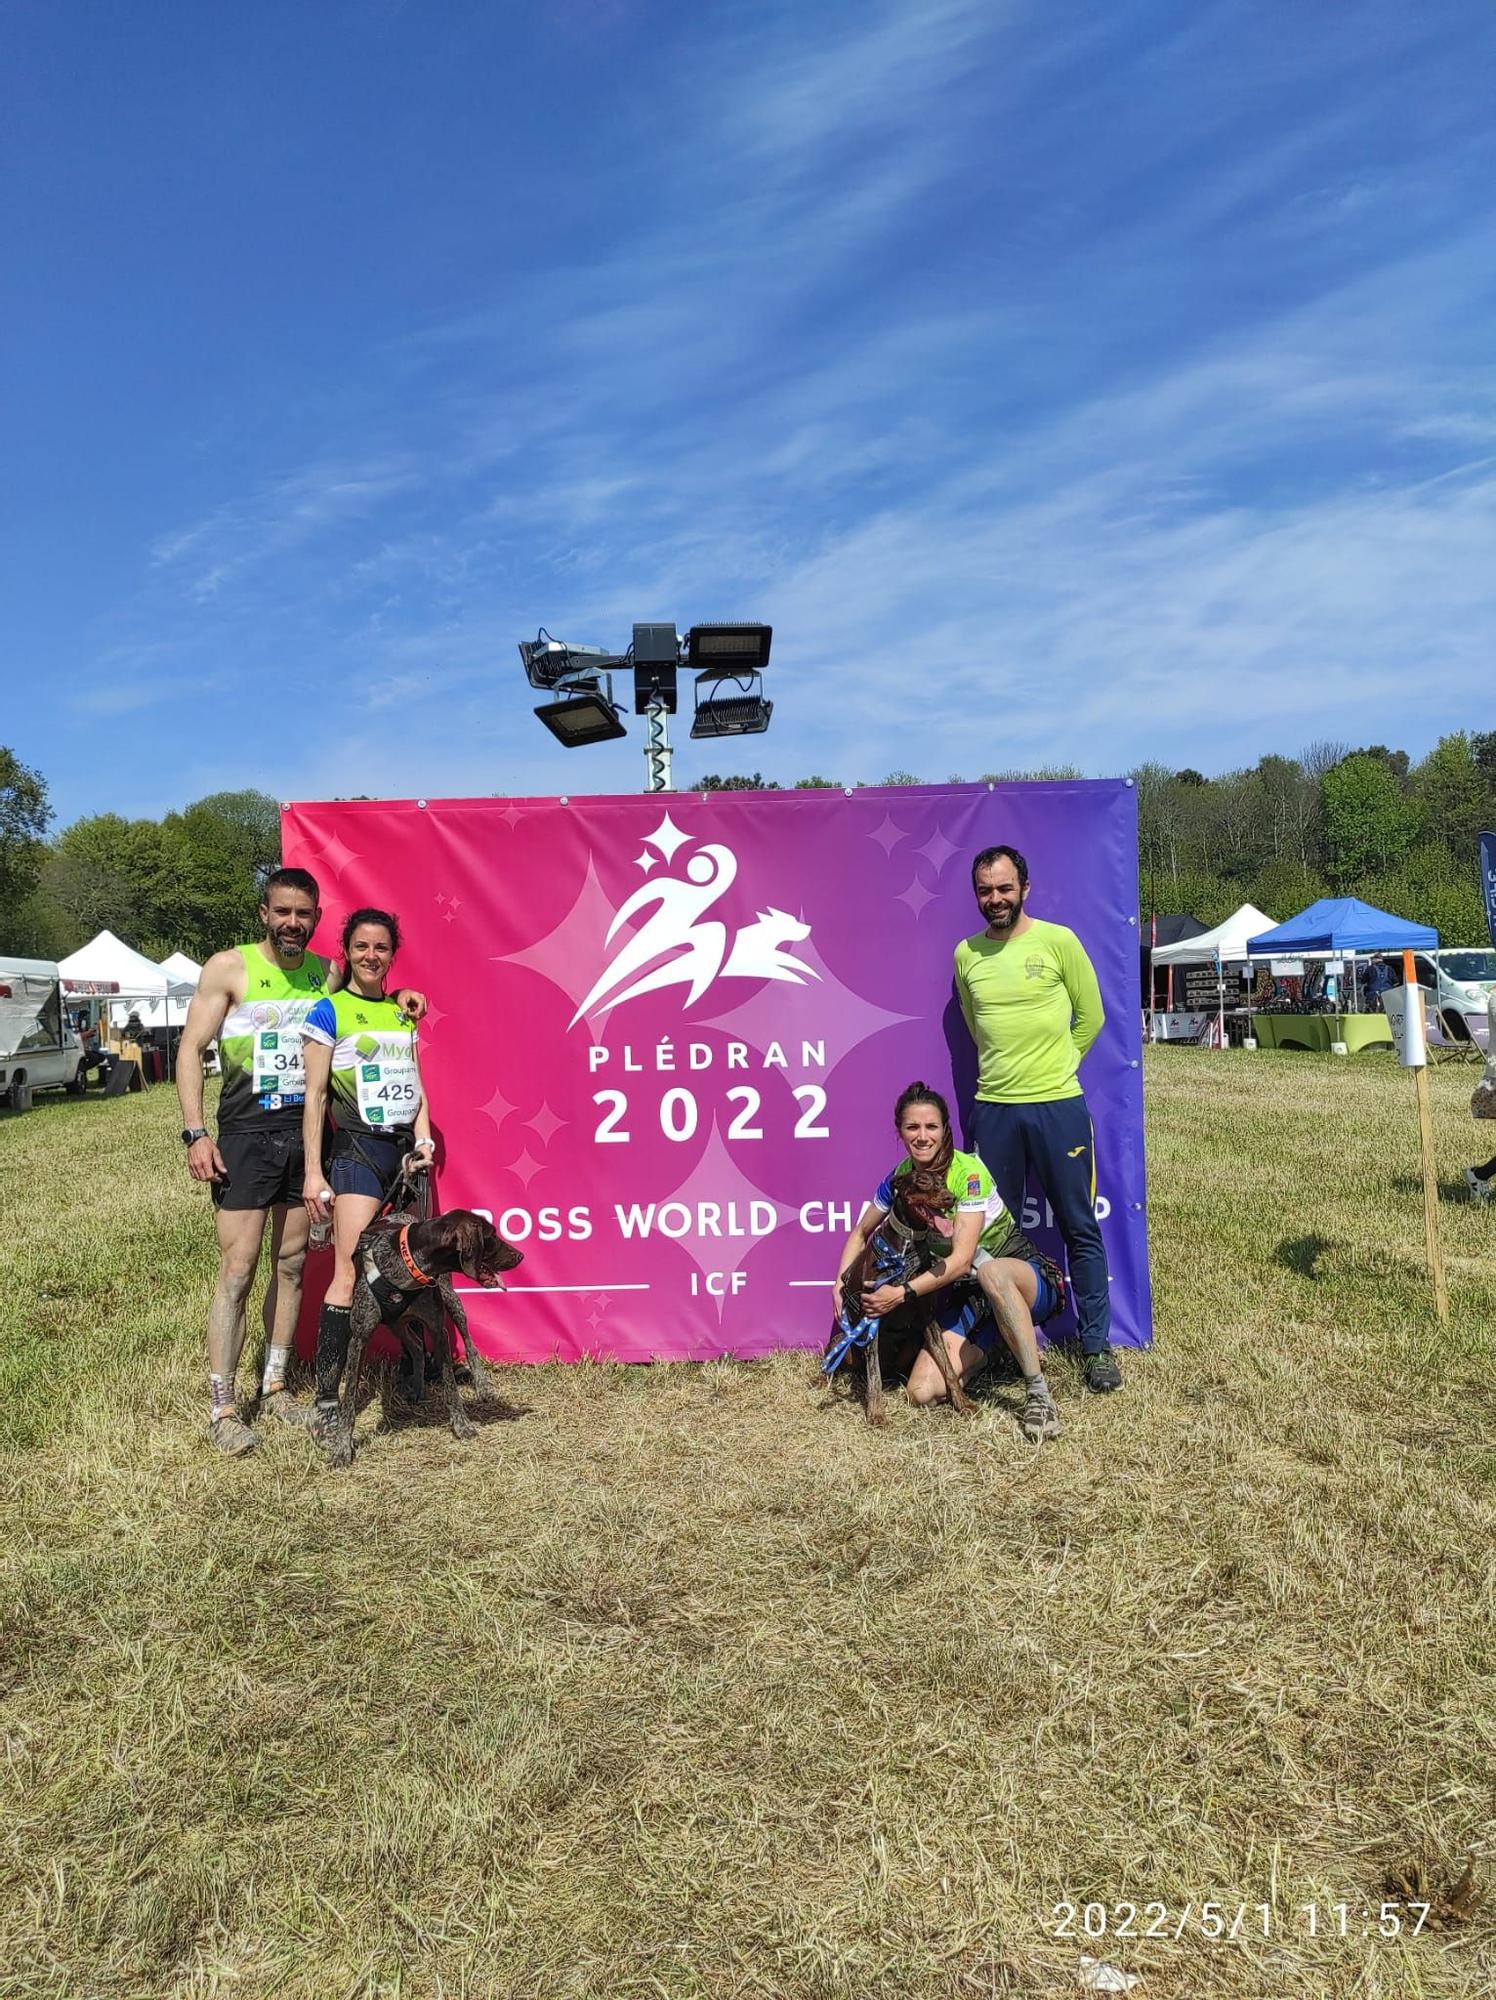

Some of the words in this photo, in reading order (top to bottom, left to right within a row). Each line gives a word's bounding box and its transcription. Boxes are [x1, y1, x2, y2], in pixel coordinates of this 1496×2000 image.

[589, 1035, 826, 1072] PLÉDRAN
[377, 1084, 415, 1101] 425
[593, 1084, 830, 1143] 2022
[471, 1206, 593, 1242] OSS
[614, 1200, 778, 1238] WORLD
[690, 1271, 748, 1296] ICF
